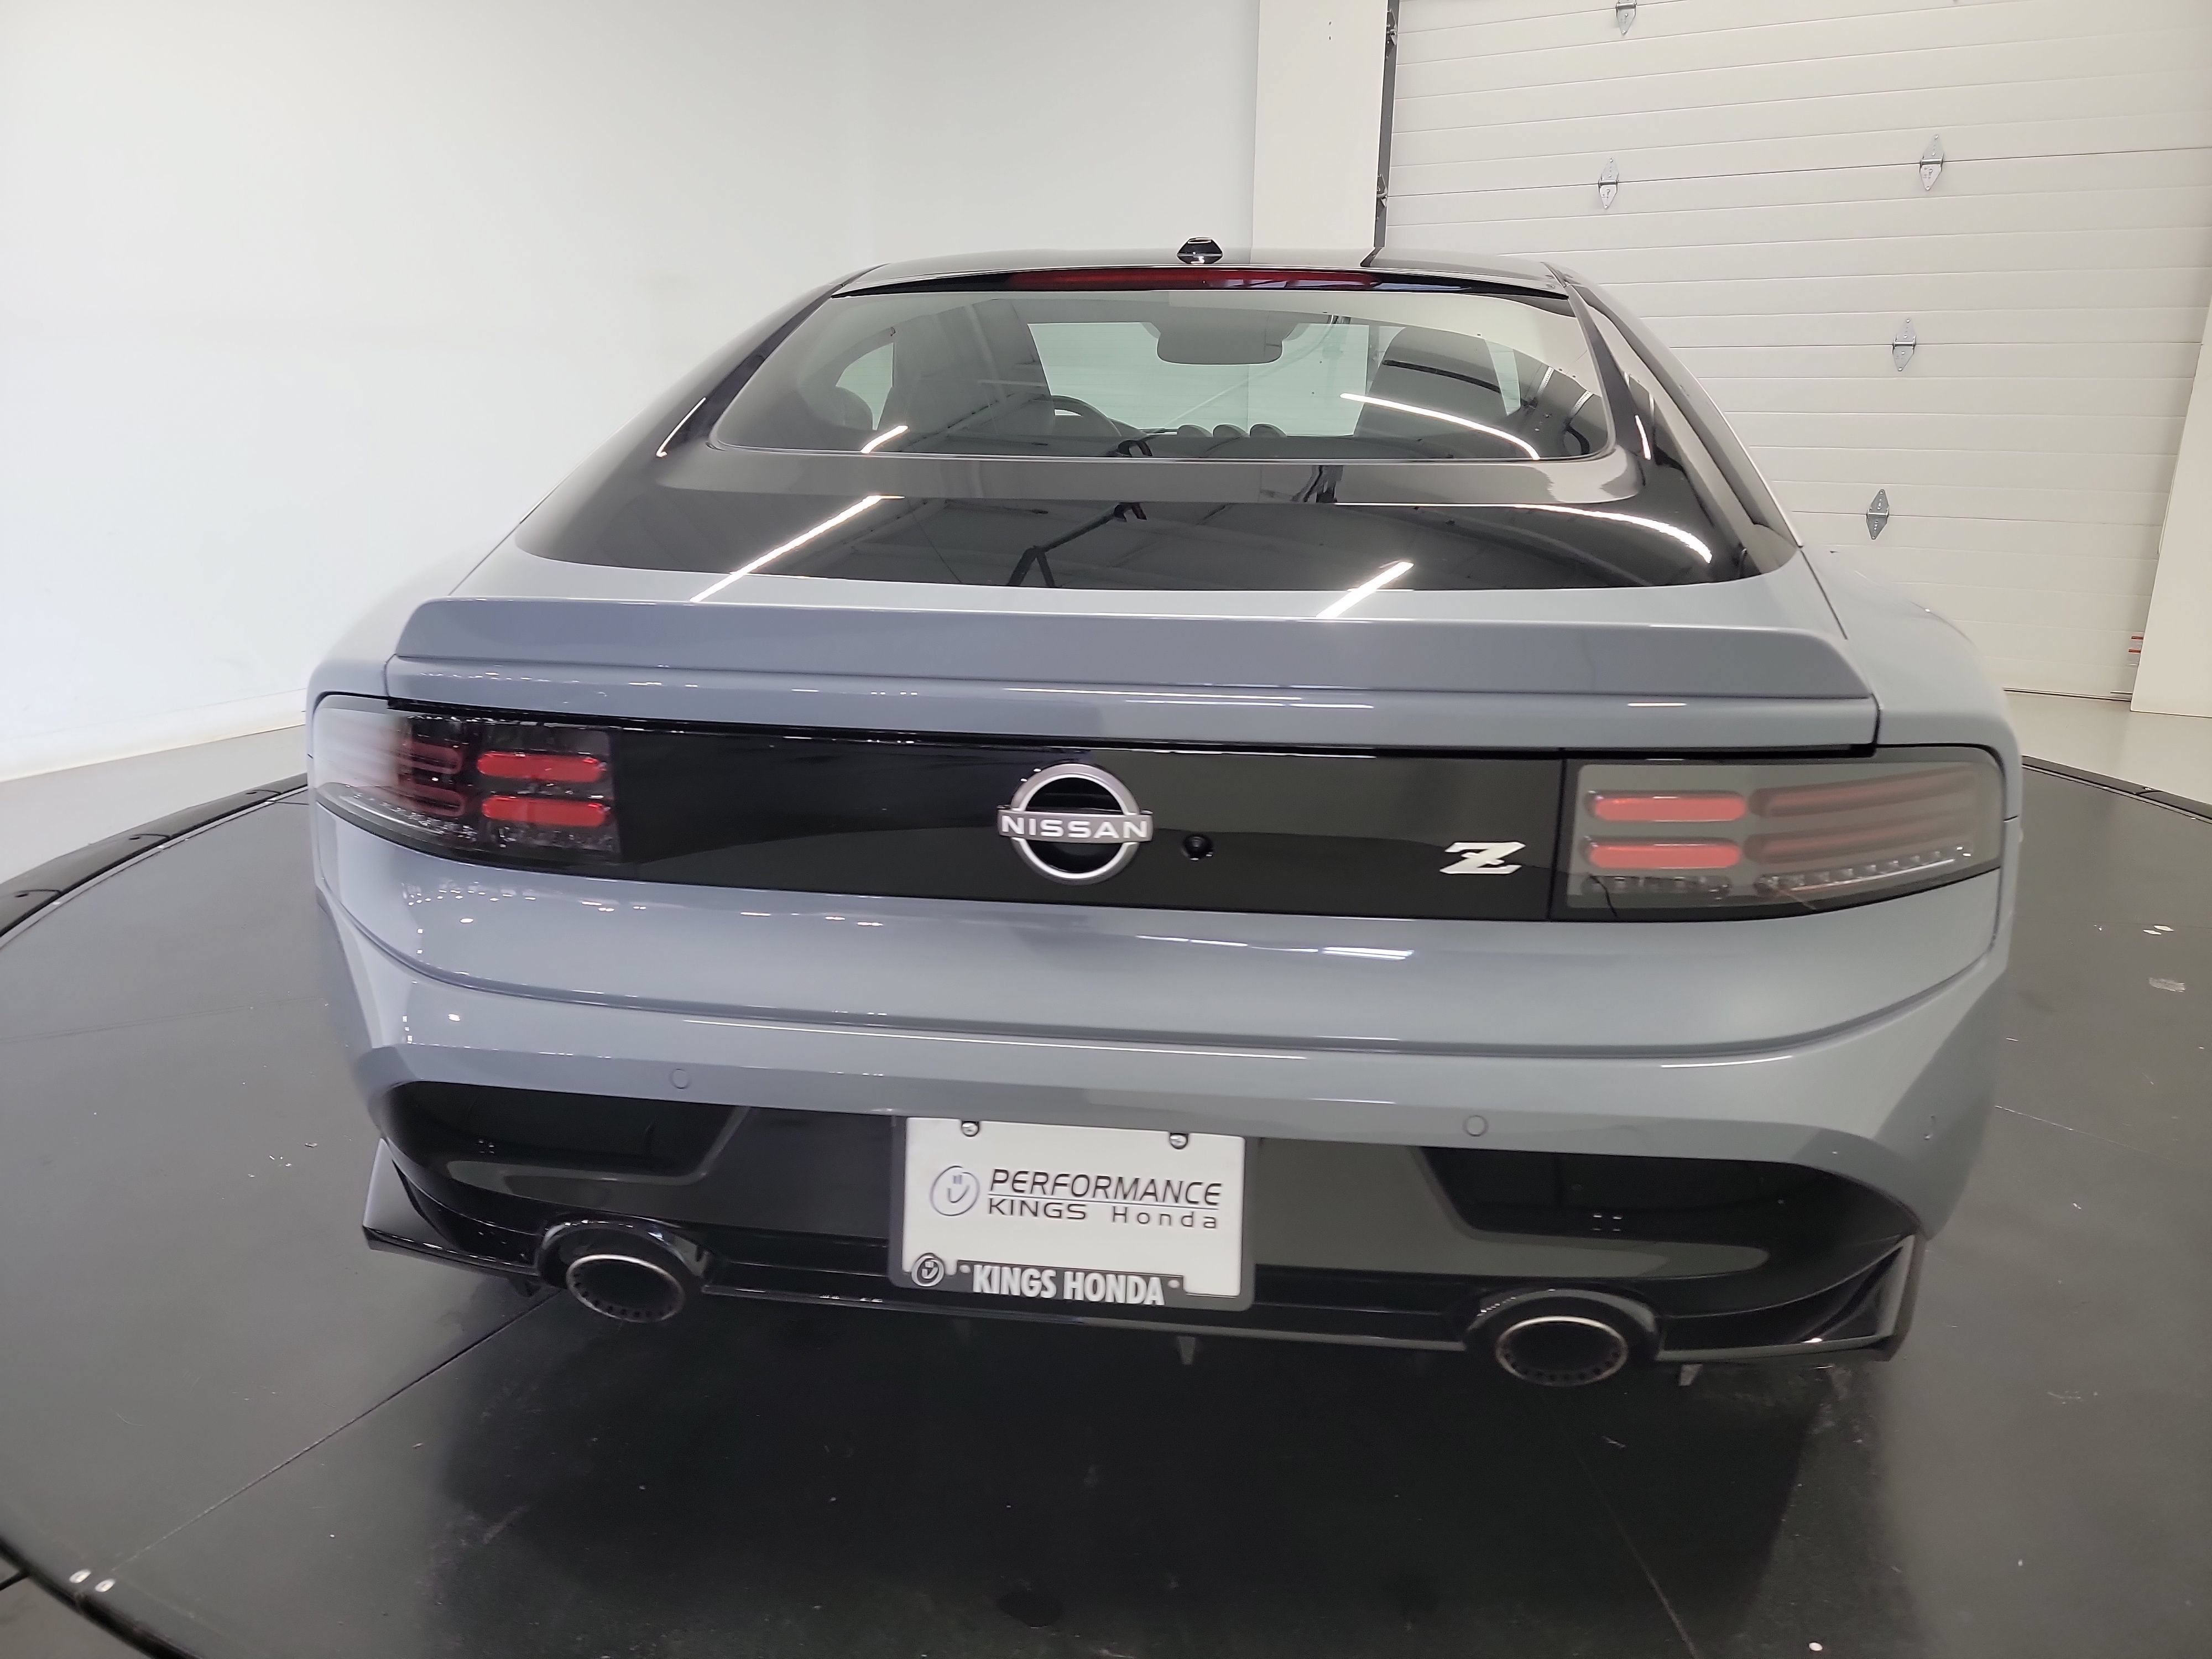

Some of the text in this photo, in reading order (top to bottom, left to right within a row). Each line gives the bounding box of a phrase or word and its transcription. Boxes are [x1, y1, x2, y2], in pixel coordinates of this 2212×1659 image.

[1001, 815, 1148, 839] NISSAN
[1439, 842, 1526, 874] Z
[988, 1168, 1222, 1206] PERFORMANCE
[988, 1198, 1217, 1229] KINGS Honda
[972, 1264, 1165, 1306] KINGS HONDA
